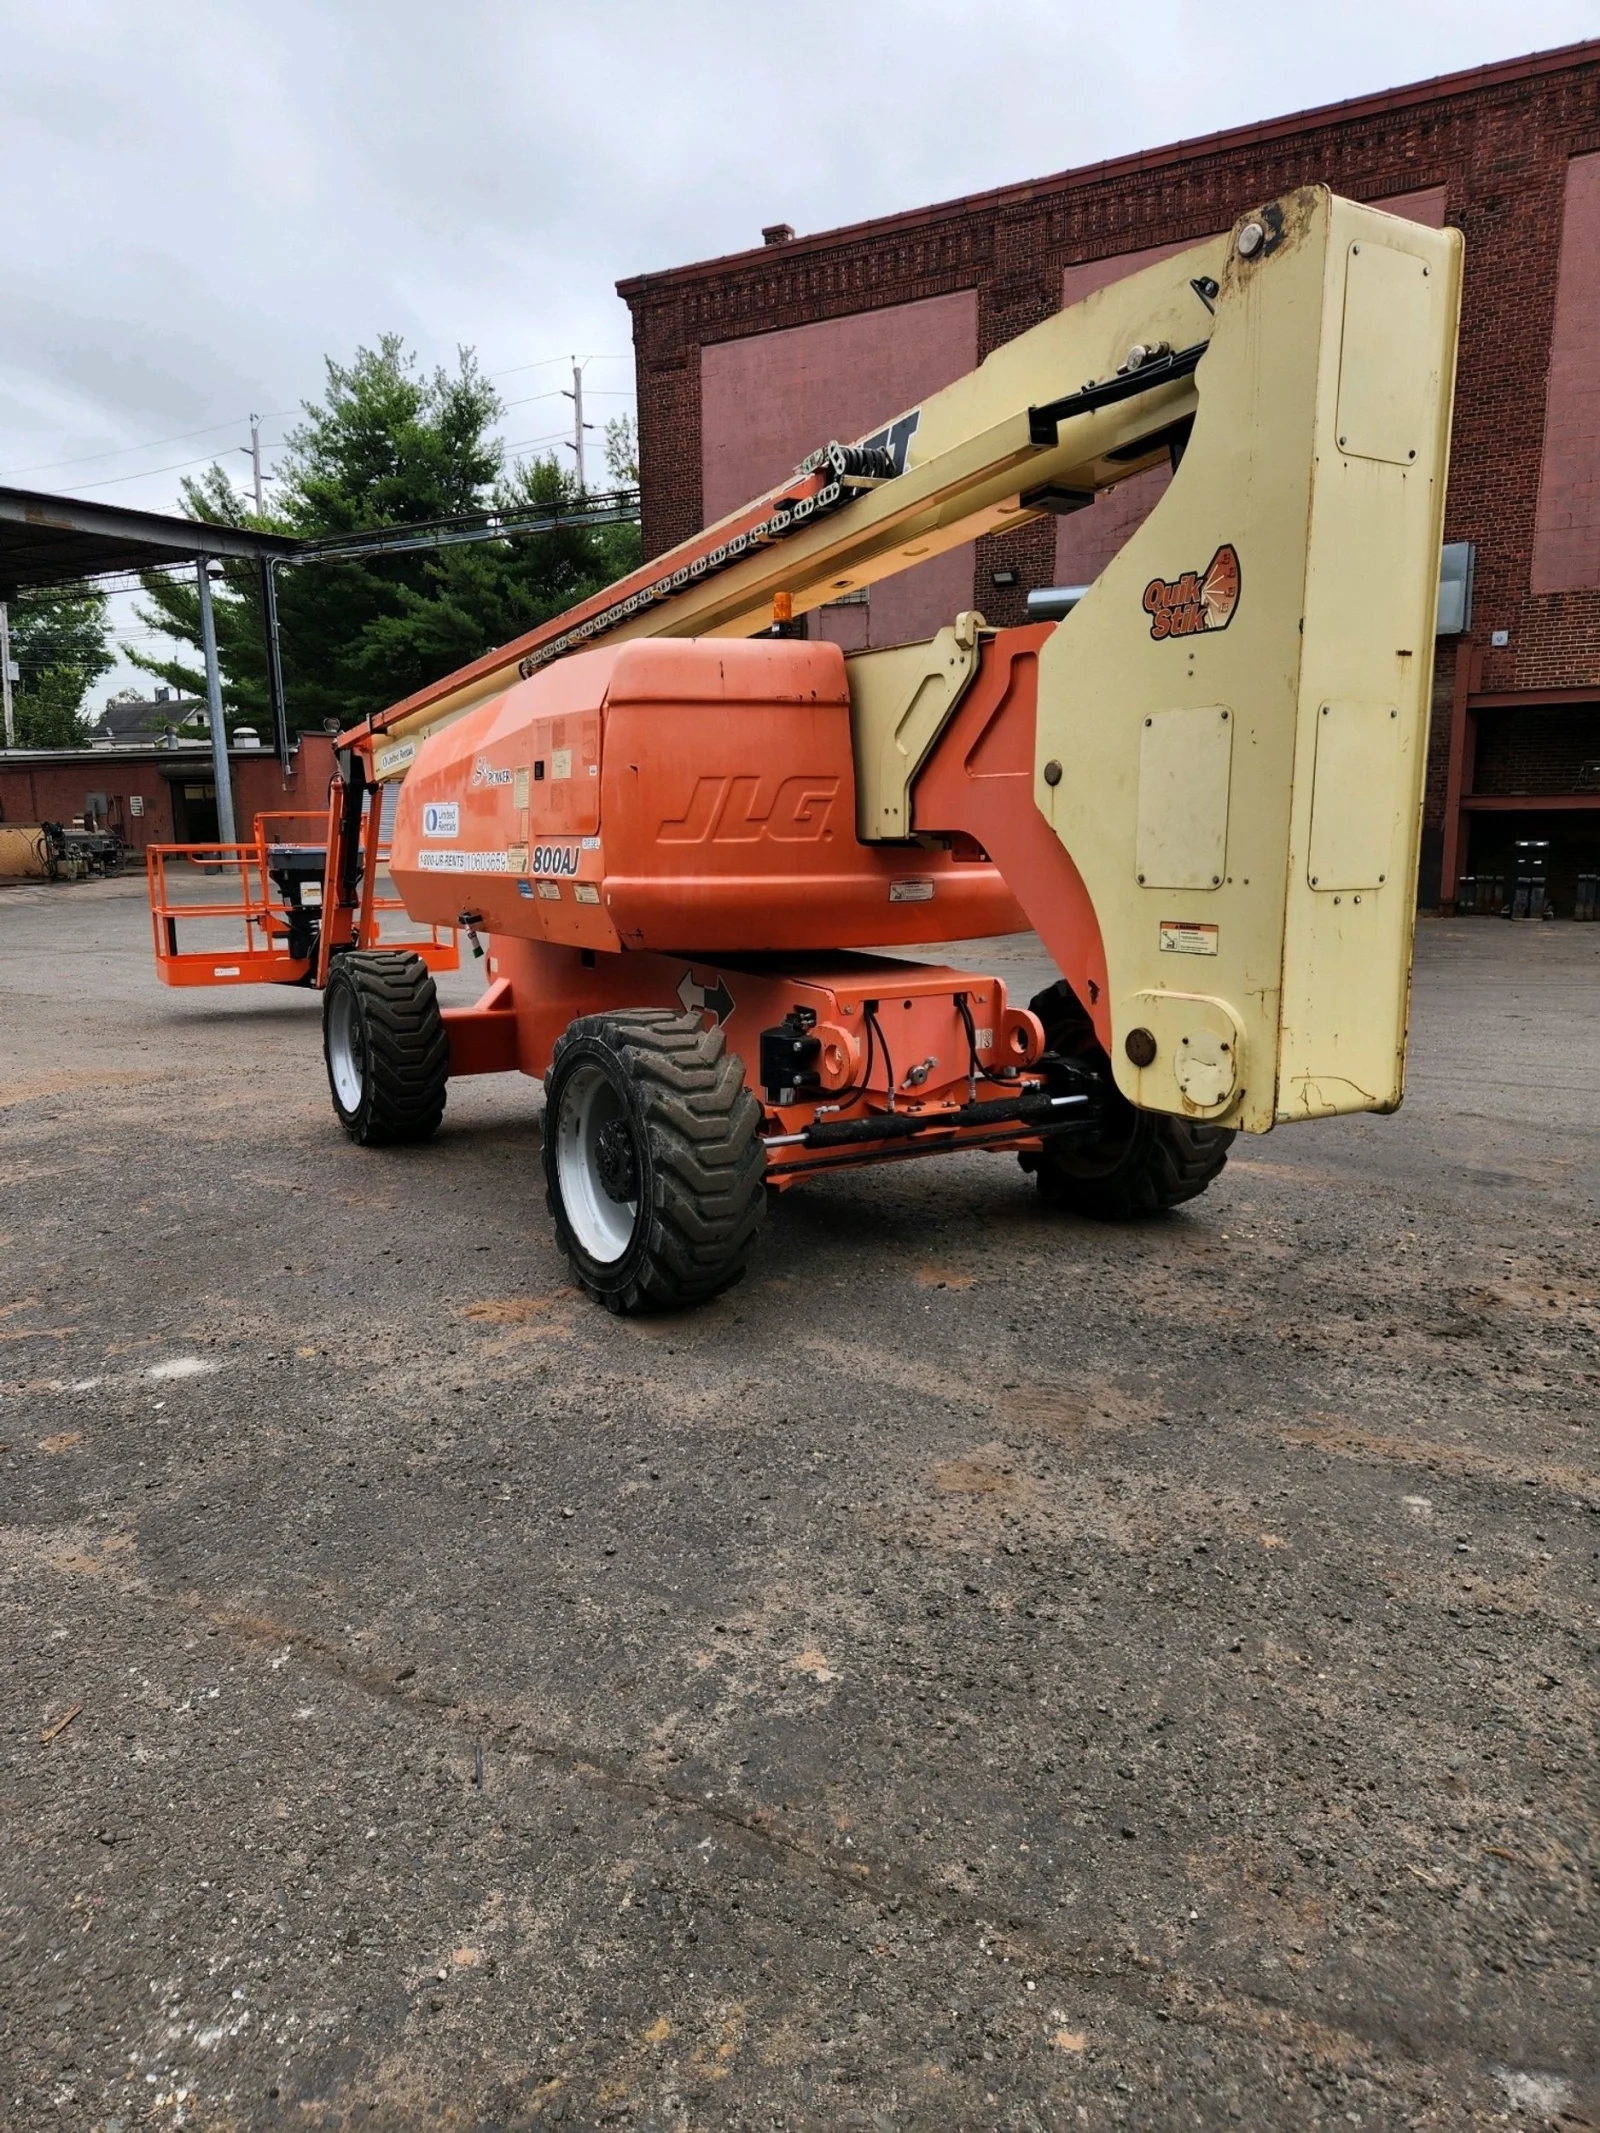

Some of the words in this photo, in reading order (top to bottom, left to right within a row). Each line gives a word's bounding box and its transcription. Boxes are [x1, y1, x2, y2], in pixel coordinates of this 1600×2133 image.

[1144, 574, 1203, 613] Quik
[1151, 603, 1208, 638] Stik
[438, 807, 456, 819] United
[656, 776, 840, 843] JLG
[438, 820, 457, 832] Rentals
[419, 854, 465, 868] 1-800-UR-RENTS
[533, 846, 580, 875] 800AJ
